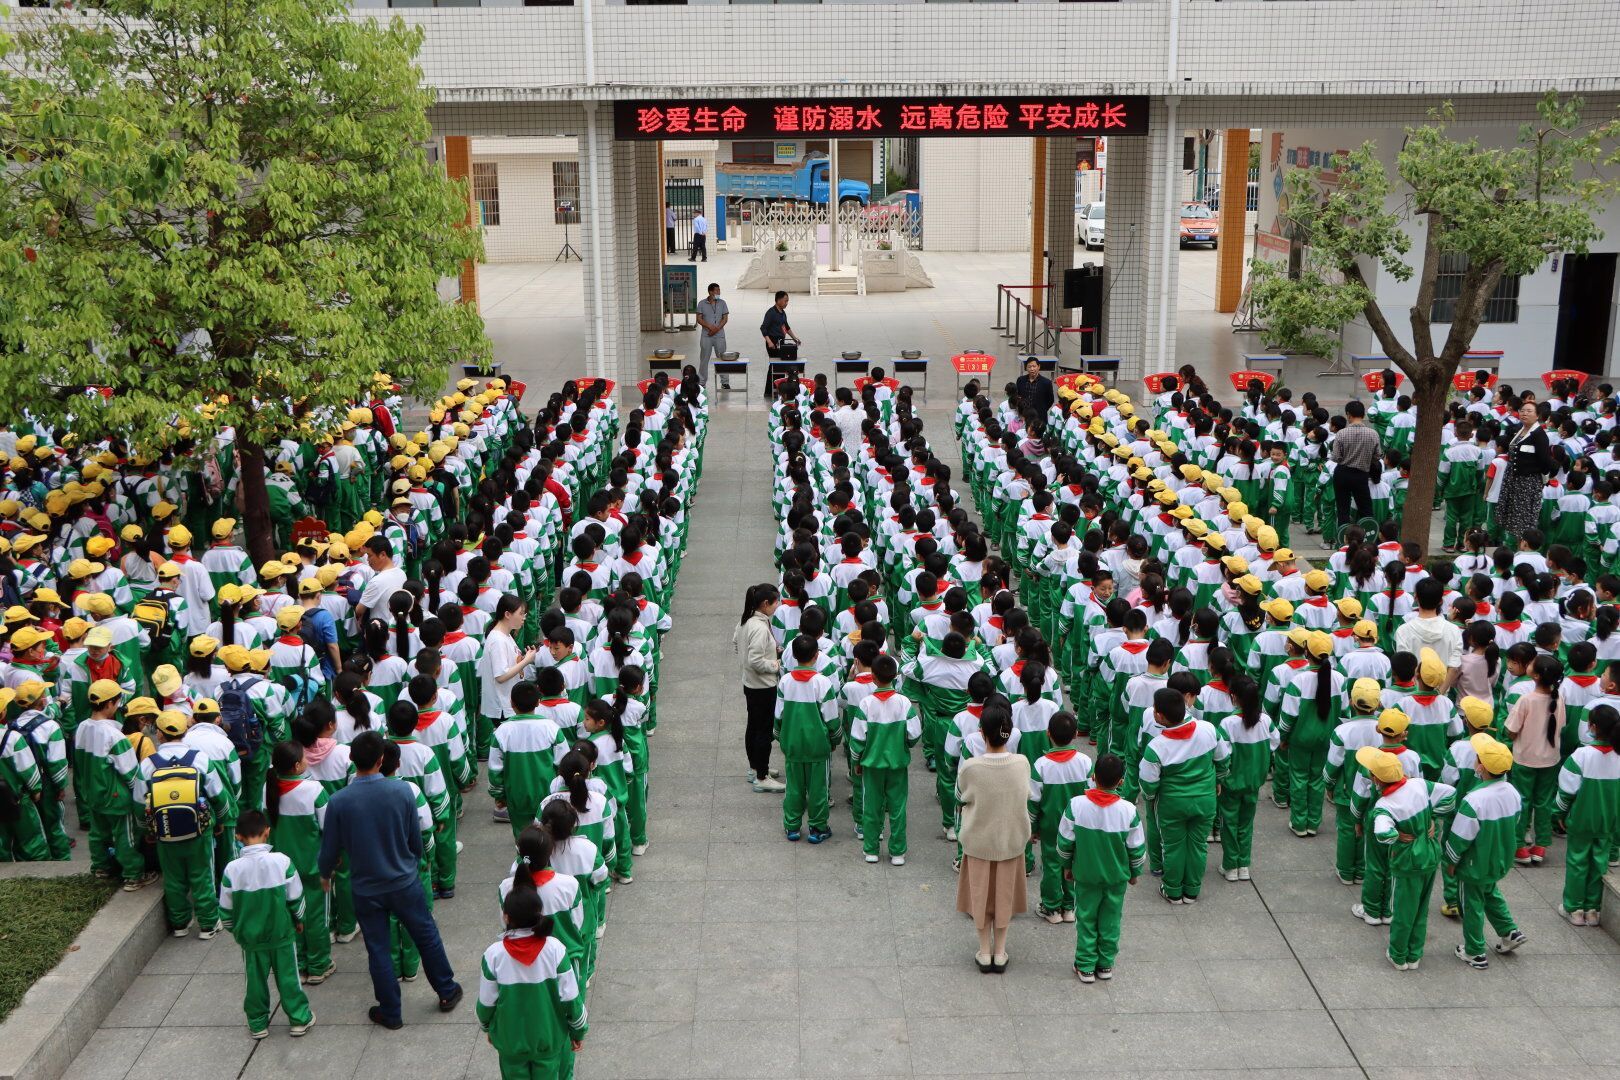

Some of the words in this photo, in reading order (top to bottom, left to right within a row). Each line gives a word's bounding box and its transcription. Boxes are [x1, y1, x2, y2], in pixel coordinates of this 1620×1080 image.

[637, 105, 748, 133] 珍爱生命
[773, 105, 883, 131] 谨防溺水
[900, 103, 1010, 130] 远离危险
[1019, 102, 1127, 129] 平安成长
